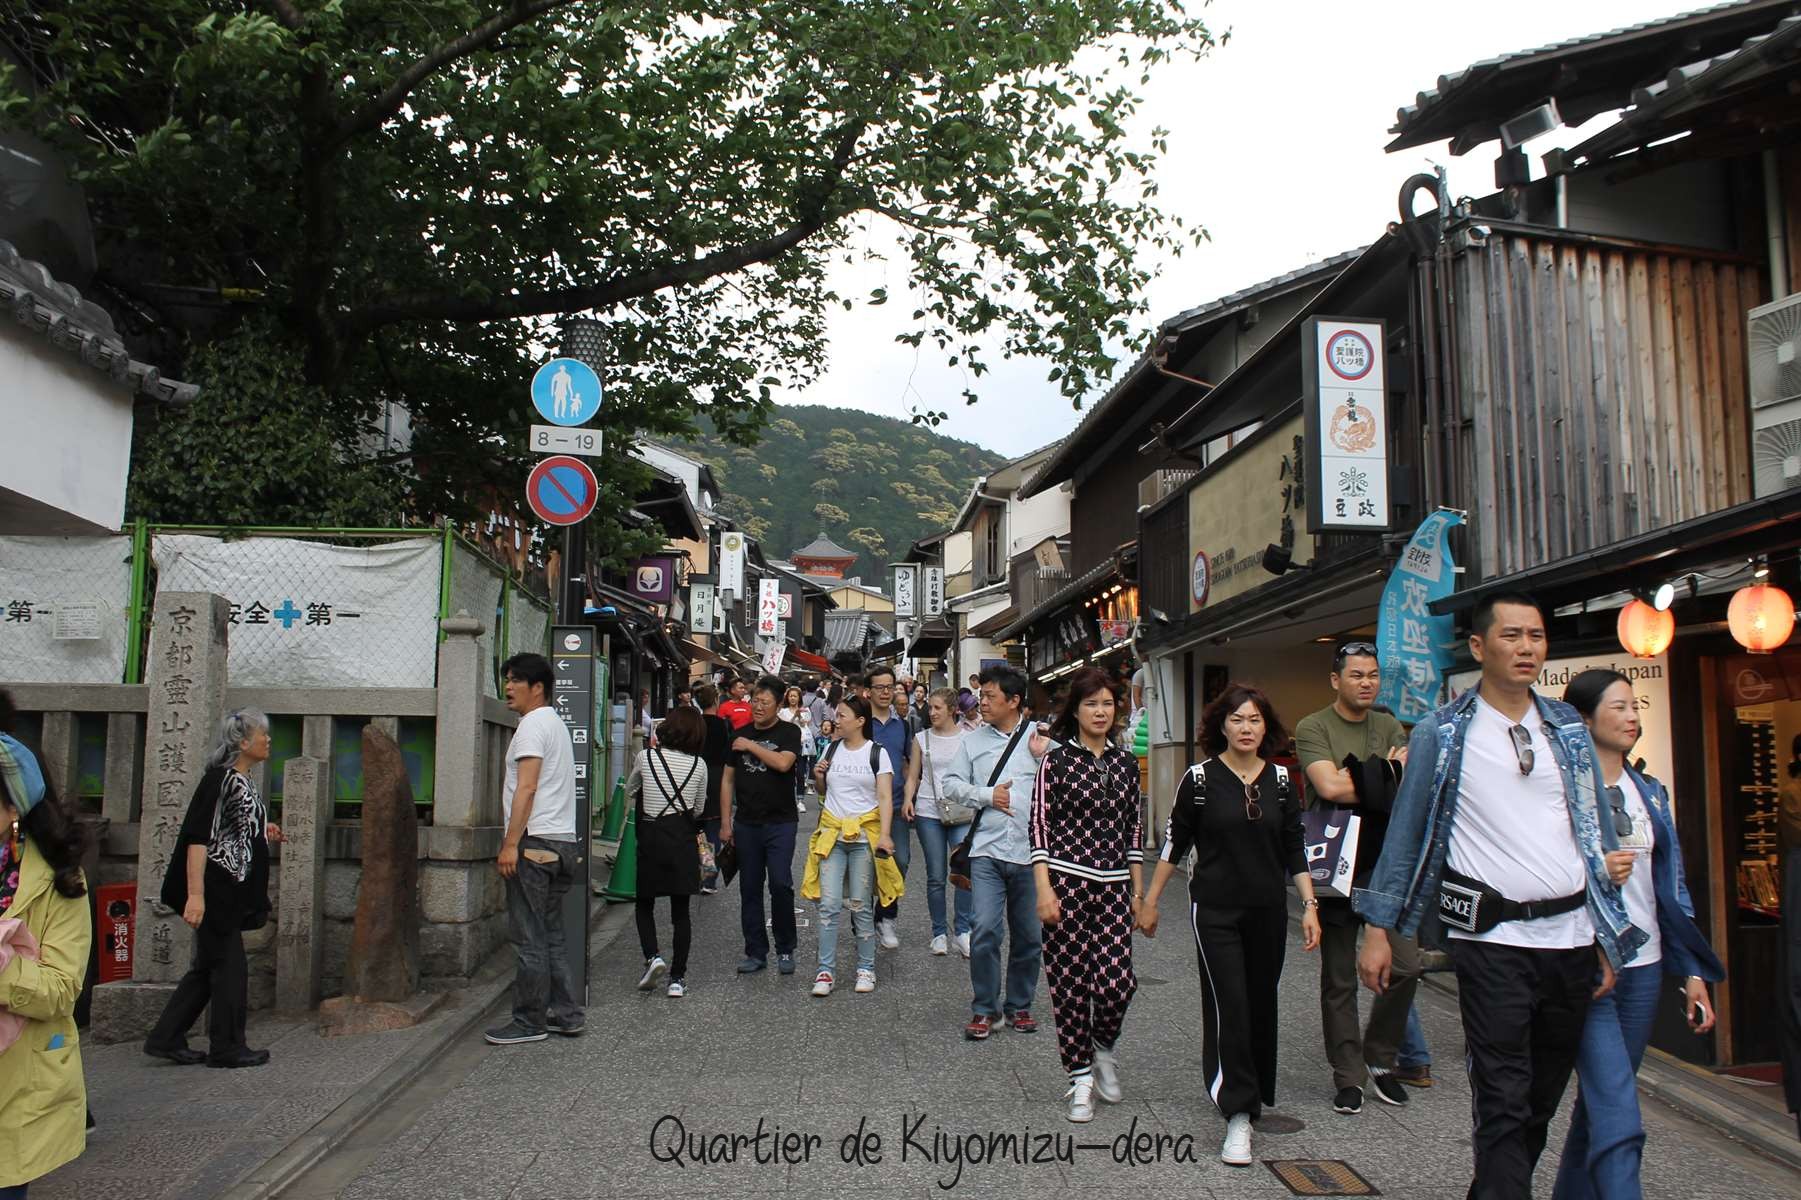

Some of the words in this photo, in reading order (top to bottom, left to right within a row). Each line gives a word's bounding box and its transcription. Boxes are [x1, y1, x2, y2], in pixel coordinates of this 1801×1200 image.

[1335, 357, 1364, 366] 八ツ橋
[537, 431, 549, 447] 8
[574, 434, 595, 450] 19
[1335, 498, 1377, 518] 豆政
[305, 602, 361, 627] 第一
[1440, 892, 1471, 917] RSACE
[114, 922, 129, 963] 消火器
